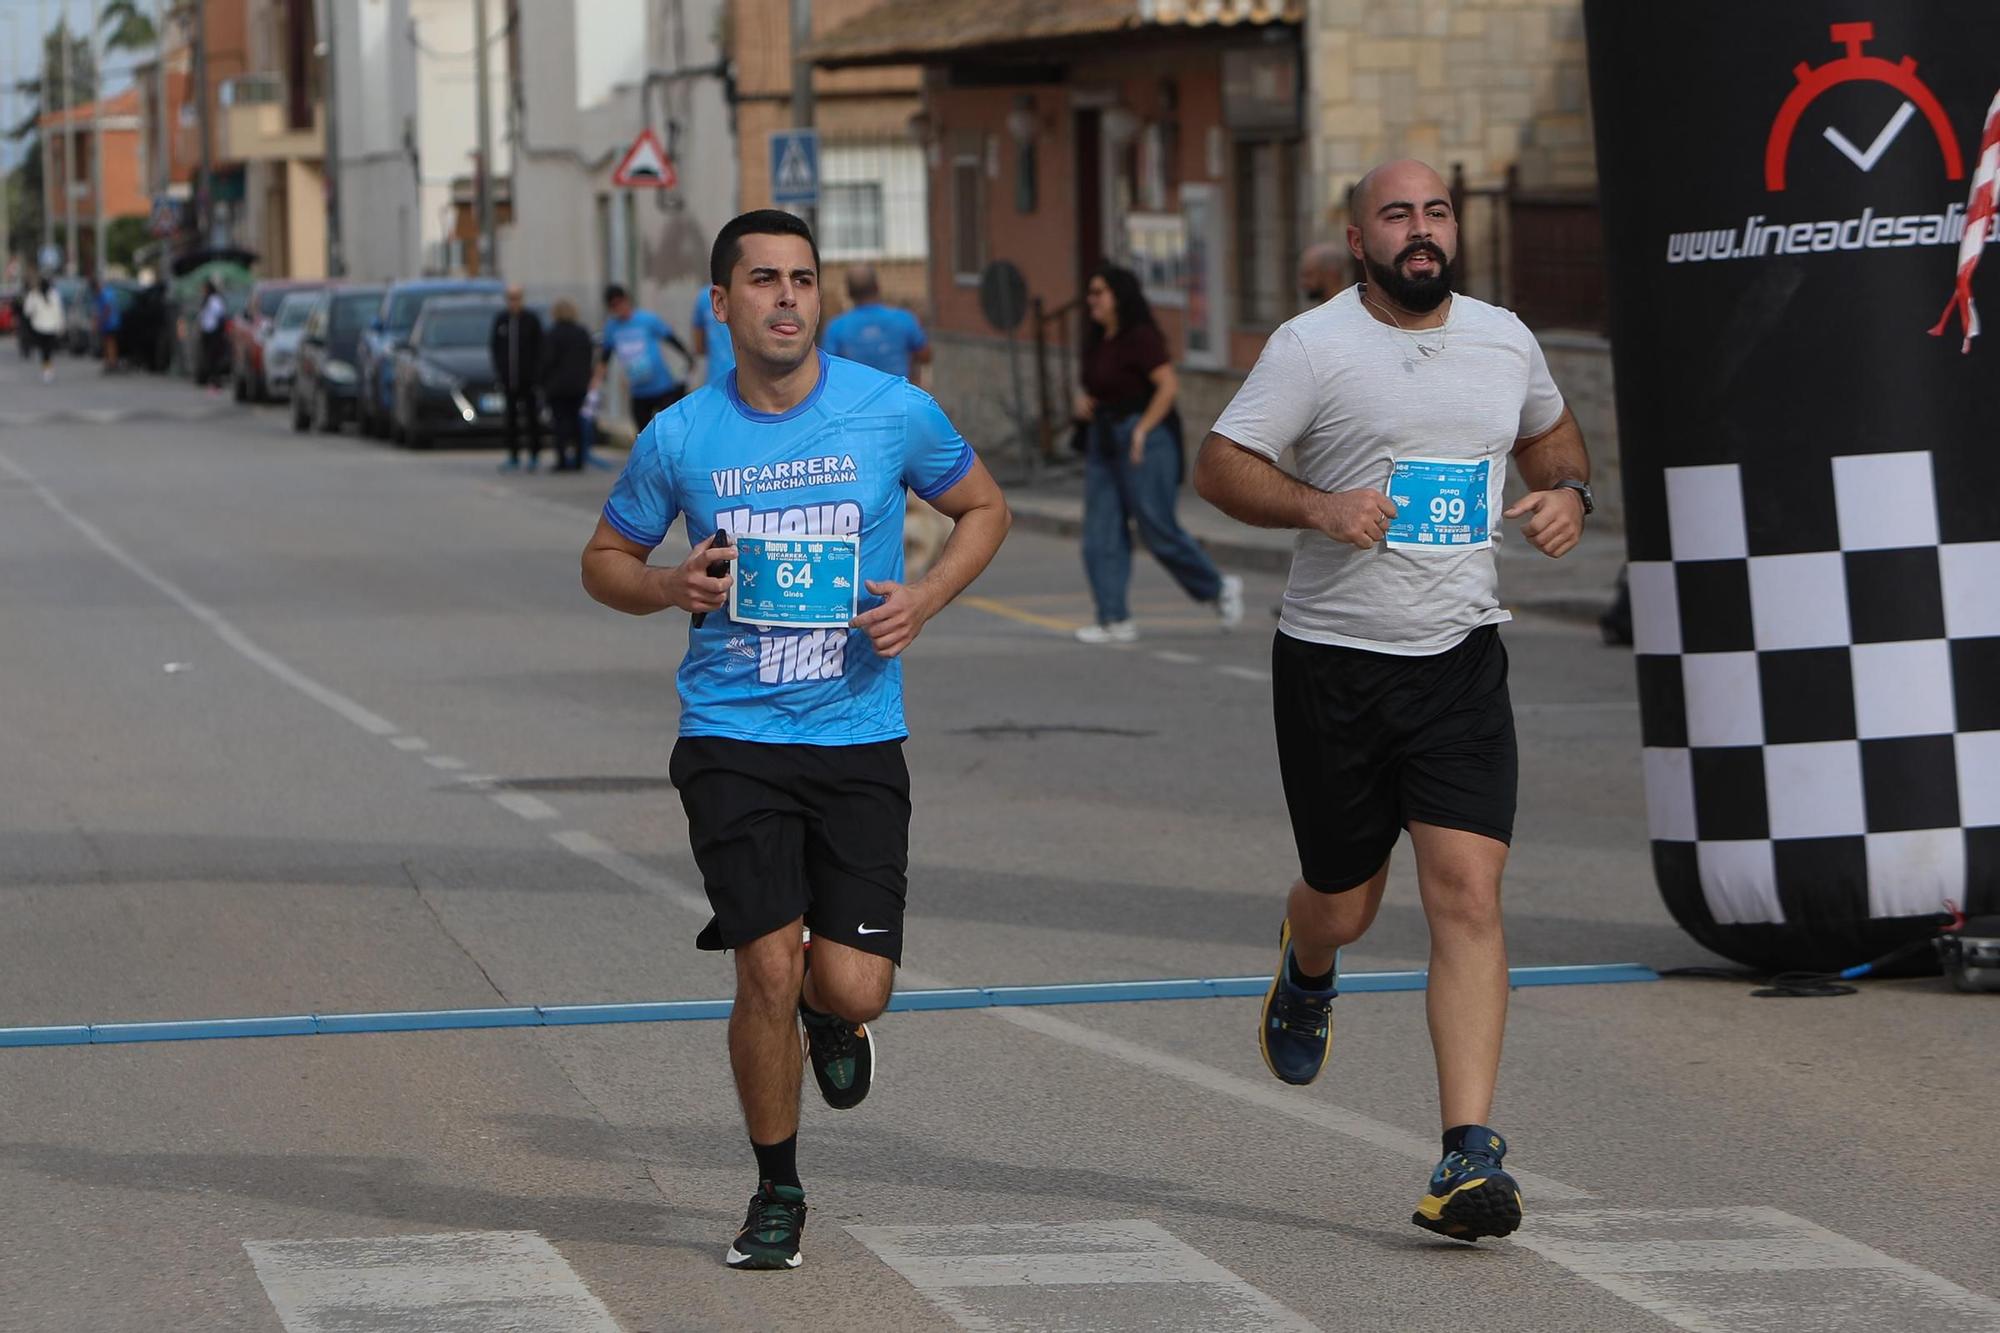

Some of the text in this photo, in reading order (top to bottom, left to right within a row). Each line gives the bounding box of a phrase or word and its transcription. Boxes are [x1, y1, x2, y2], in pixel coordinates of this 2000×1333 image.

[1667, 202, 2000, 263] www.lineadesalia
[712, 454, 856, 498] VII CARRERA
[744, 471, 857, 494] Y MARCHA URBANA
[1439, 488, 1460, 496] David
[794, 541, 802, 553] la
[776, 562, 814, 589] 64
[783, 590, 804, 598] Ginés
[759, 629, 848, 684] vida
